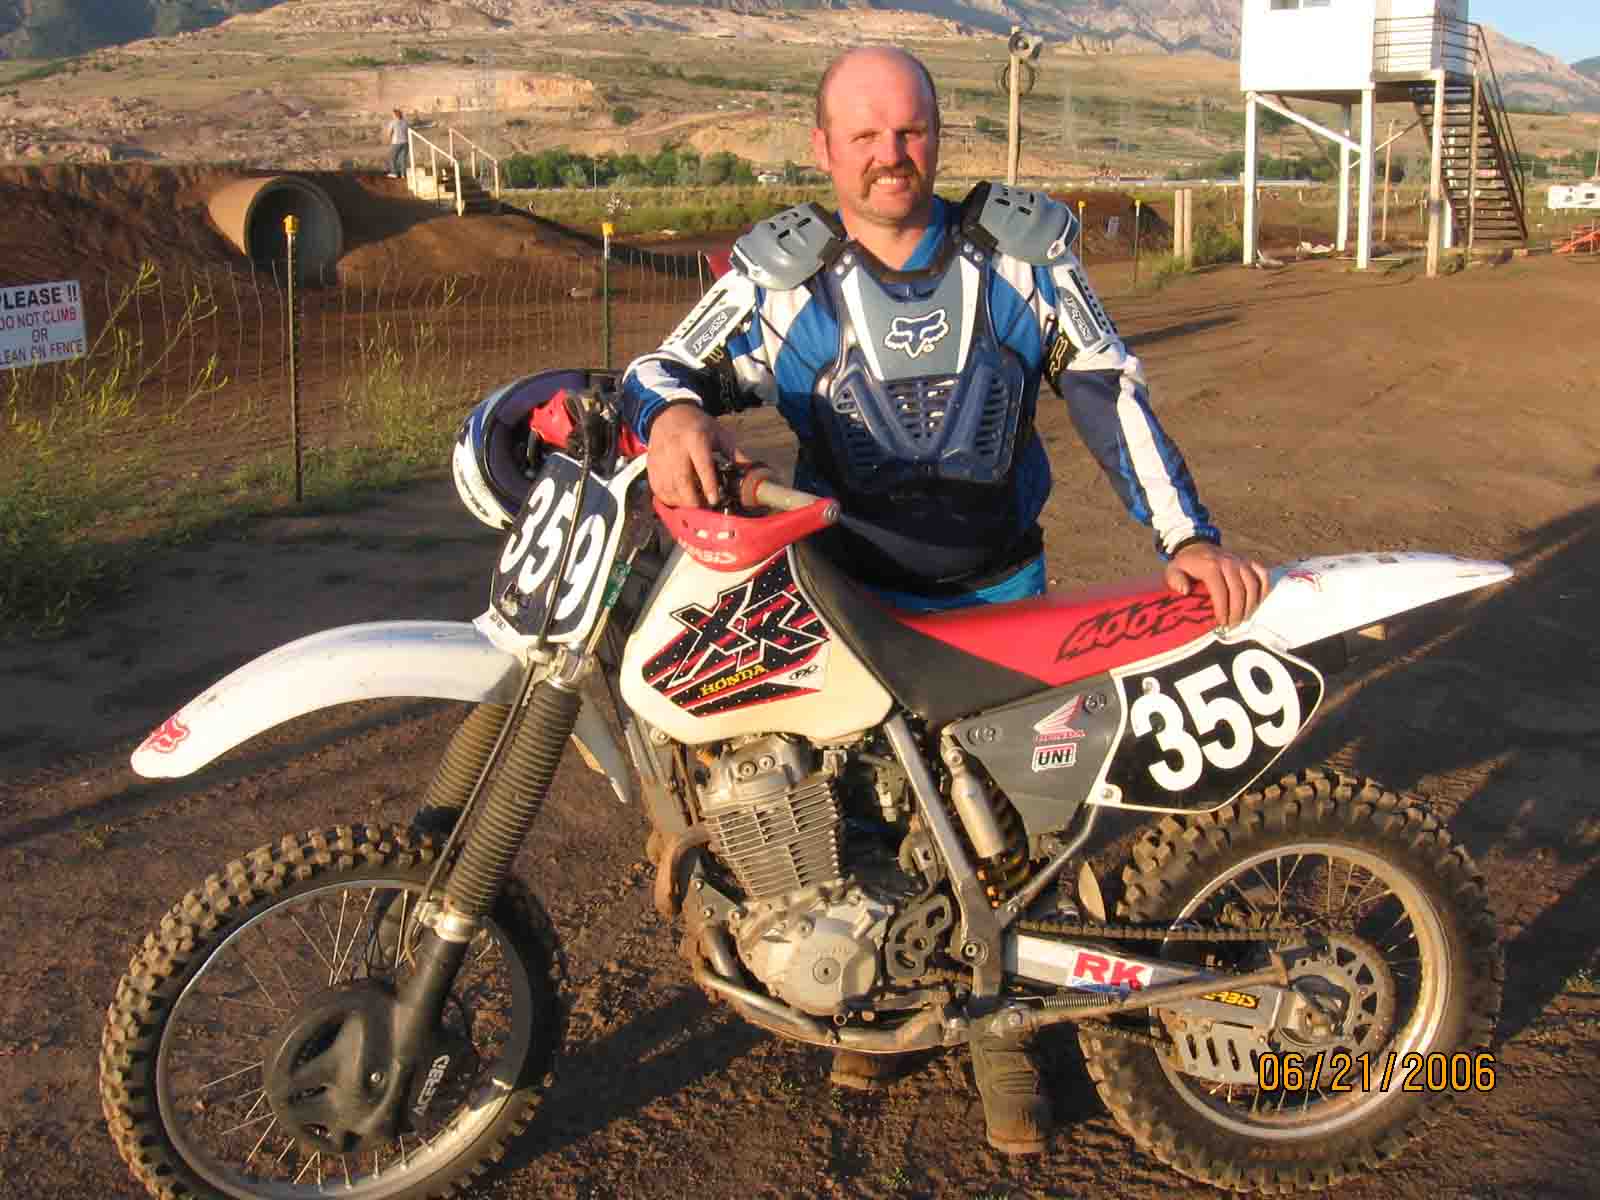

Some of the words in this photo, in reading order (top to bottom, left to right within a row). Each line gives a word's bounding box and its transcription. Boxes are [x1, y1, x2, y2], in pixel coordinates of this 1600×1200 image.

[0, 287, 63, 310] LEASE
[17, 311, 41, 329] NOT
[42, 306, 77, 325] CLIMB
[32, 328, 48, 343] OR
[49, 338, 82, 356] FENCE
[500, 477, 606, 620] 359
[699, 664, 767, 697] HONDA
[1130, 648, 1301, 791] 359
[1038, 749, 1073, 766] UNI
[1073, 951, 1146, 991] RK
